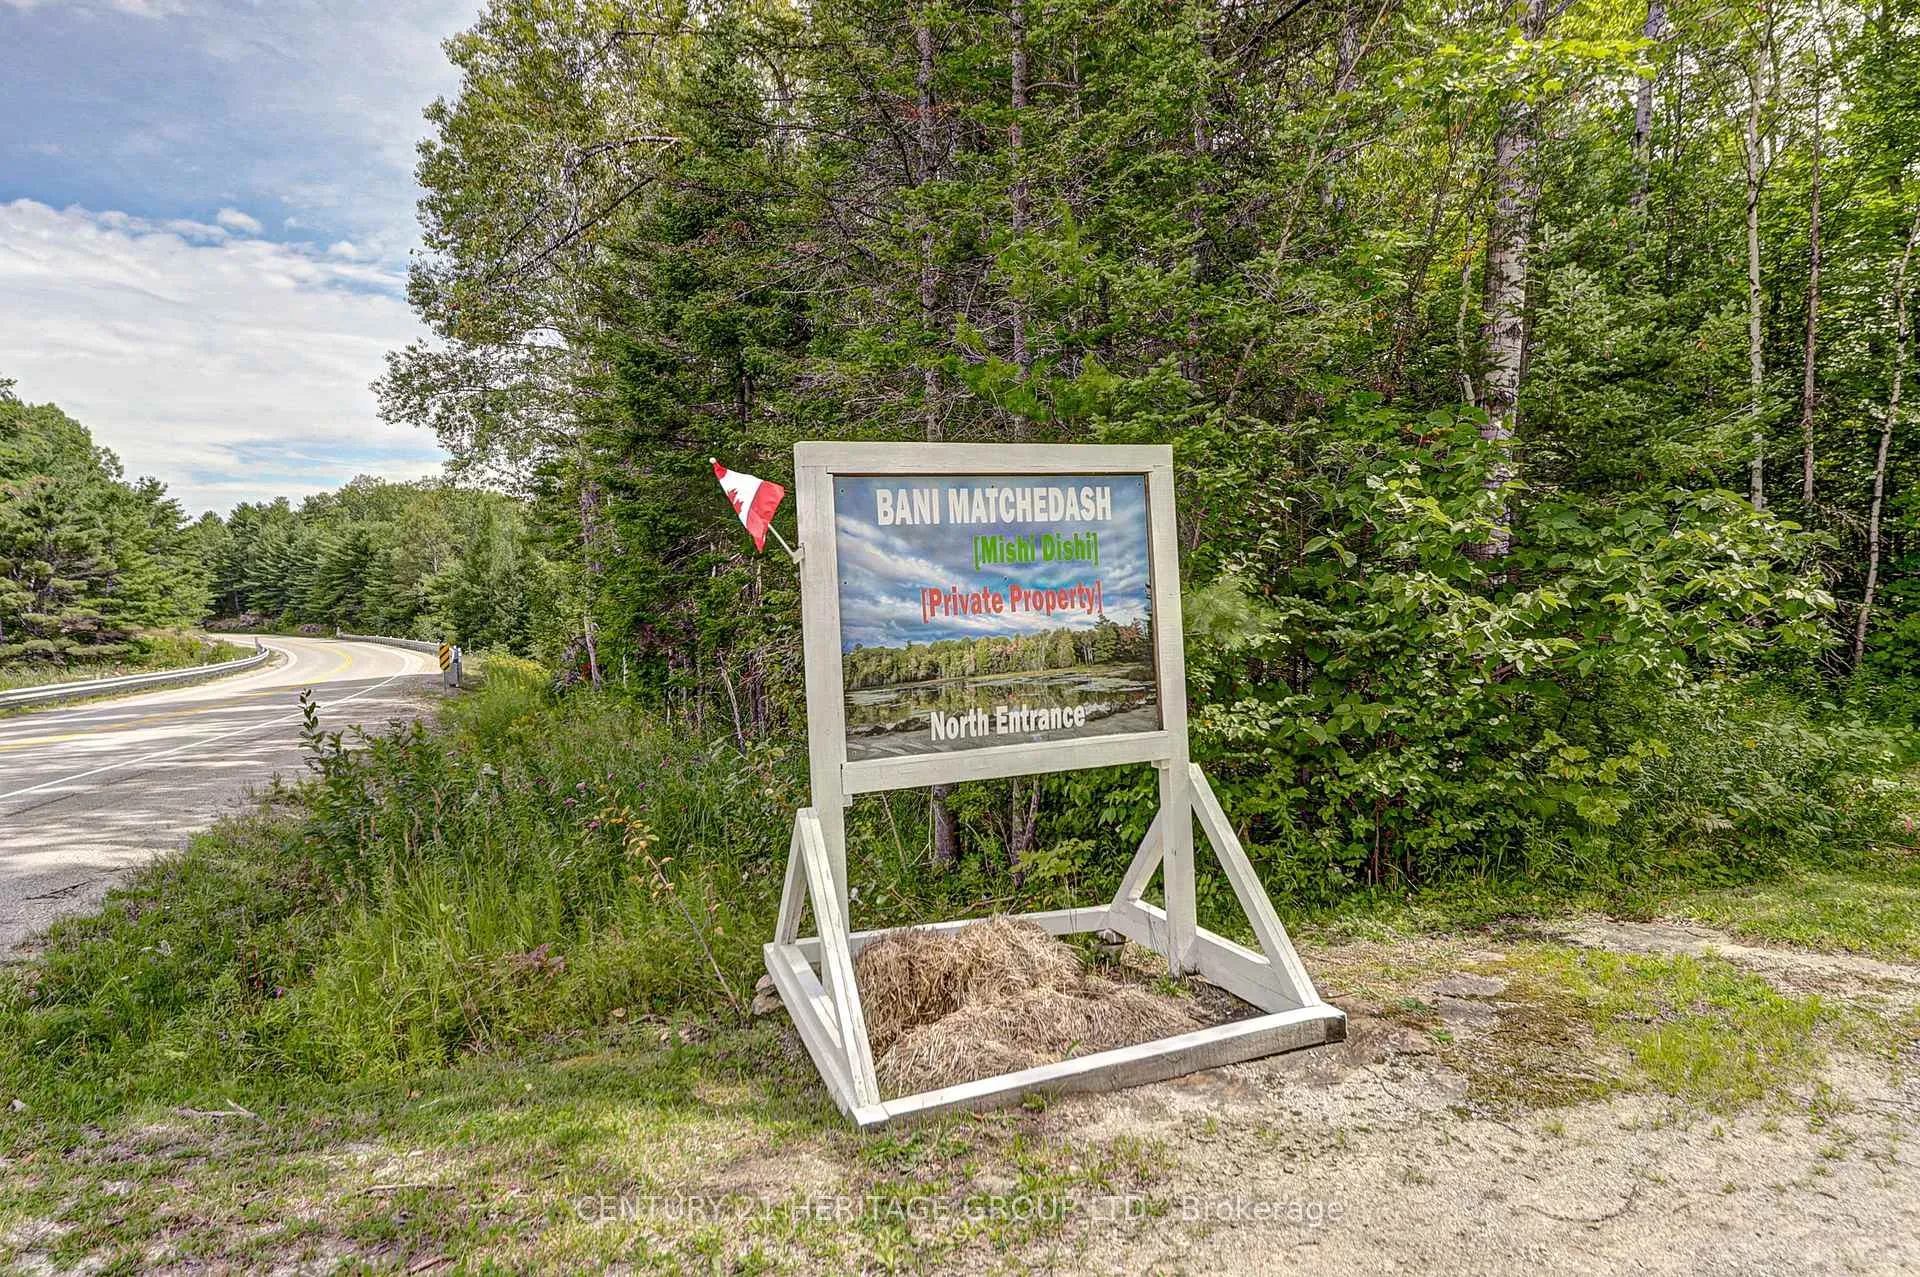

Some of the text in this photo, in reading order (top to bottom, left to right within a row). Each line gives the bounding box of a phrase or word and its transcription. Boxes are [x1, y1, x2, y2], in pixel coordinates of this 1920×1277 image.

[876, 486, 1112, 526] BANI MATCHEDASH
[921, 585, 1004, 624] [Private
[930, 703, 1086, 741] North Entrance
